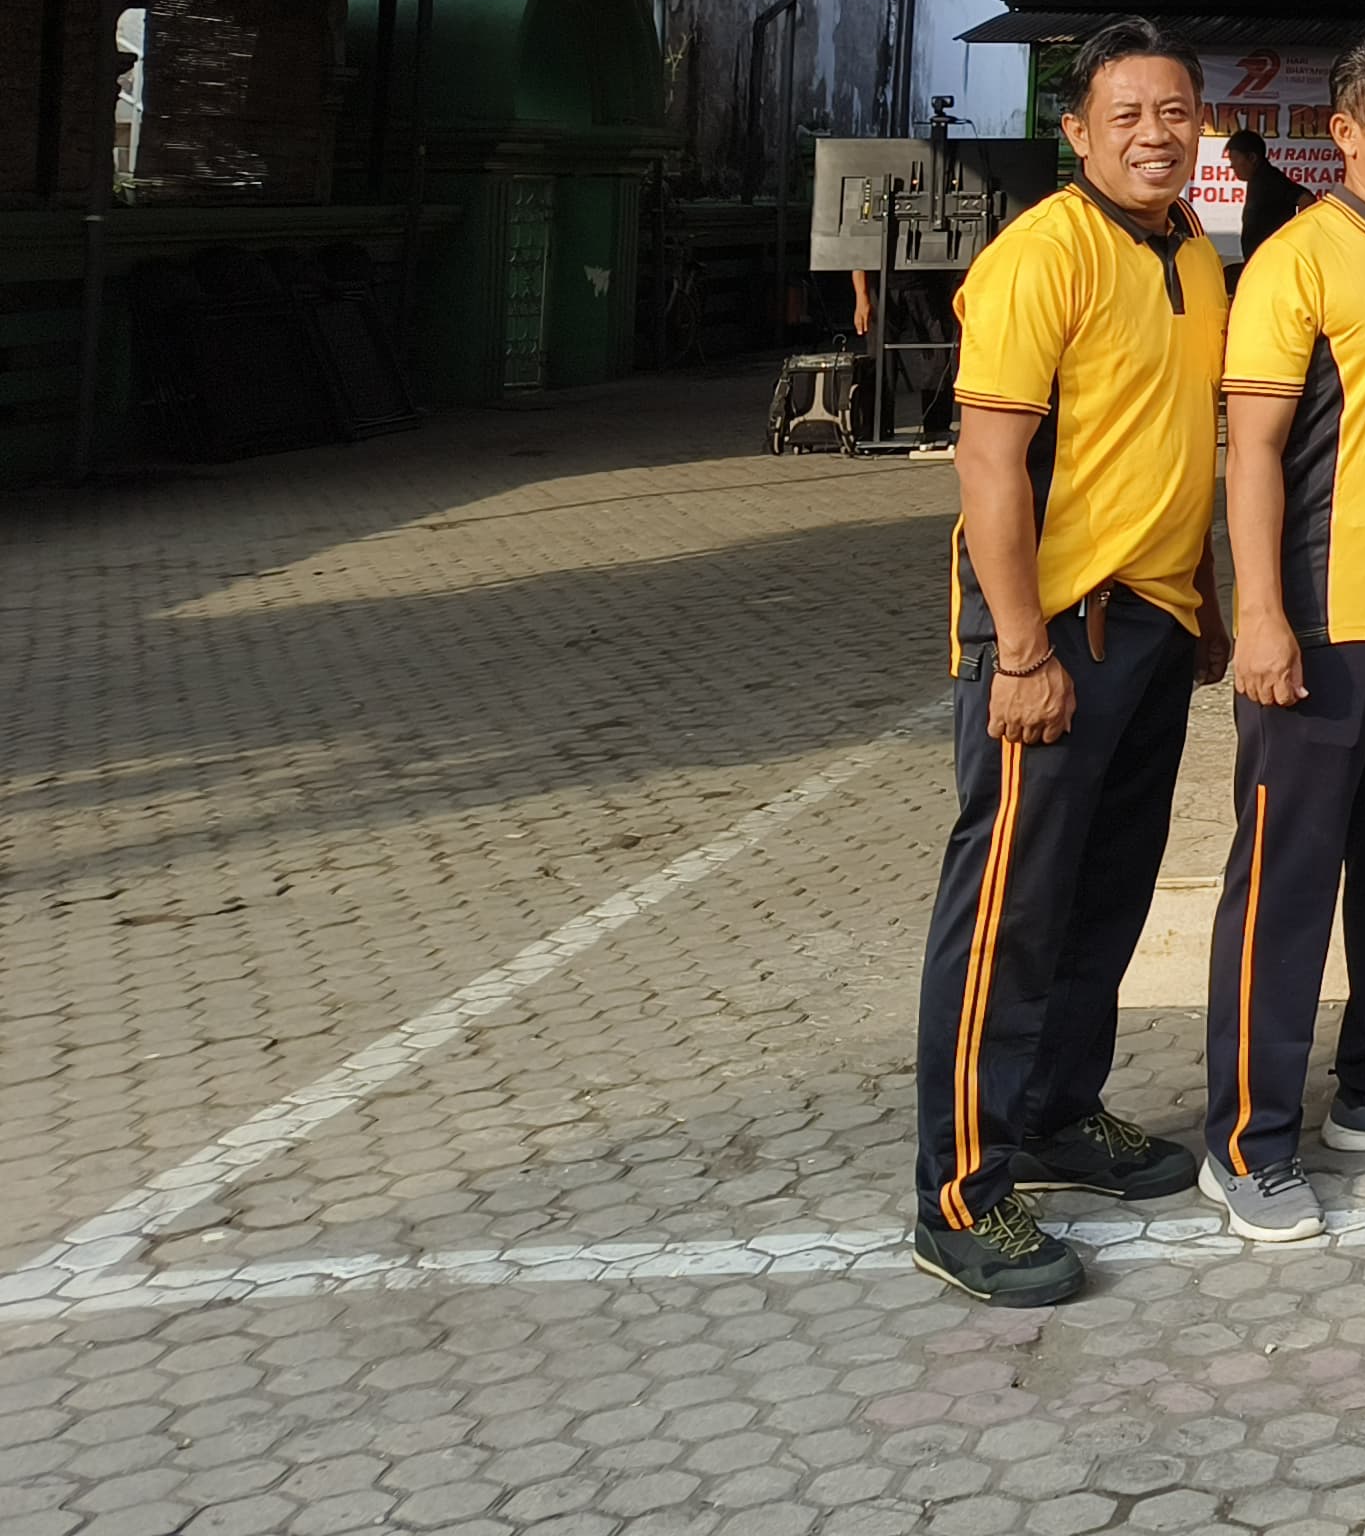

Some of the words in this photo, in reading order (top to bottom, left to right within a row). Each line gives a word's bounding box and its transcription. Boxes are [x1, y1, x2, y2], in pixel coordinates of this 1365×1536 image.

[1203, 102, 1281, 139] AKTI
[1284, 147, 1343, 161] RANGK
[1188, 186, 1245, 203] POLR
